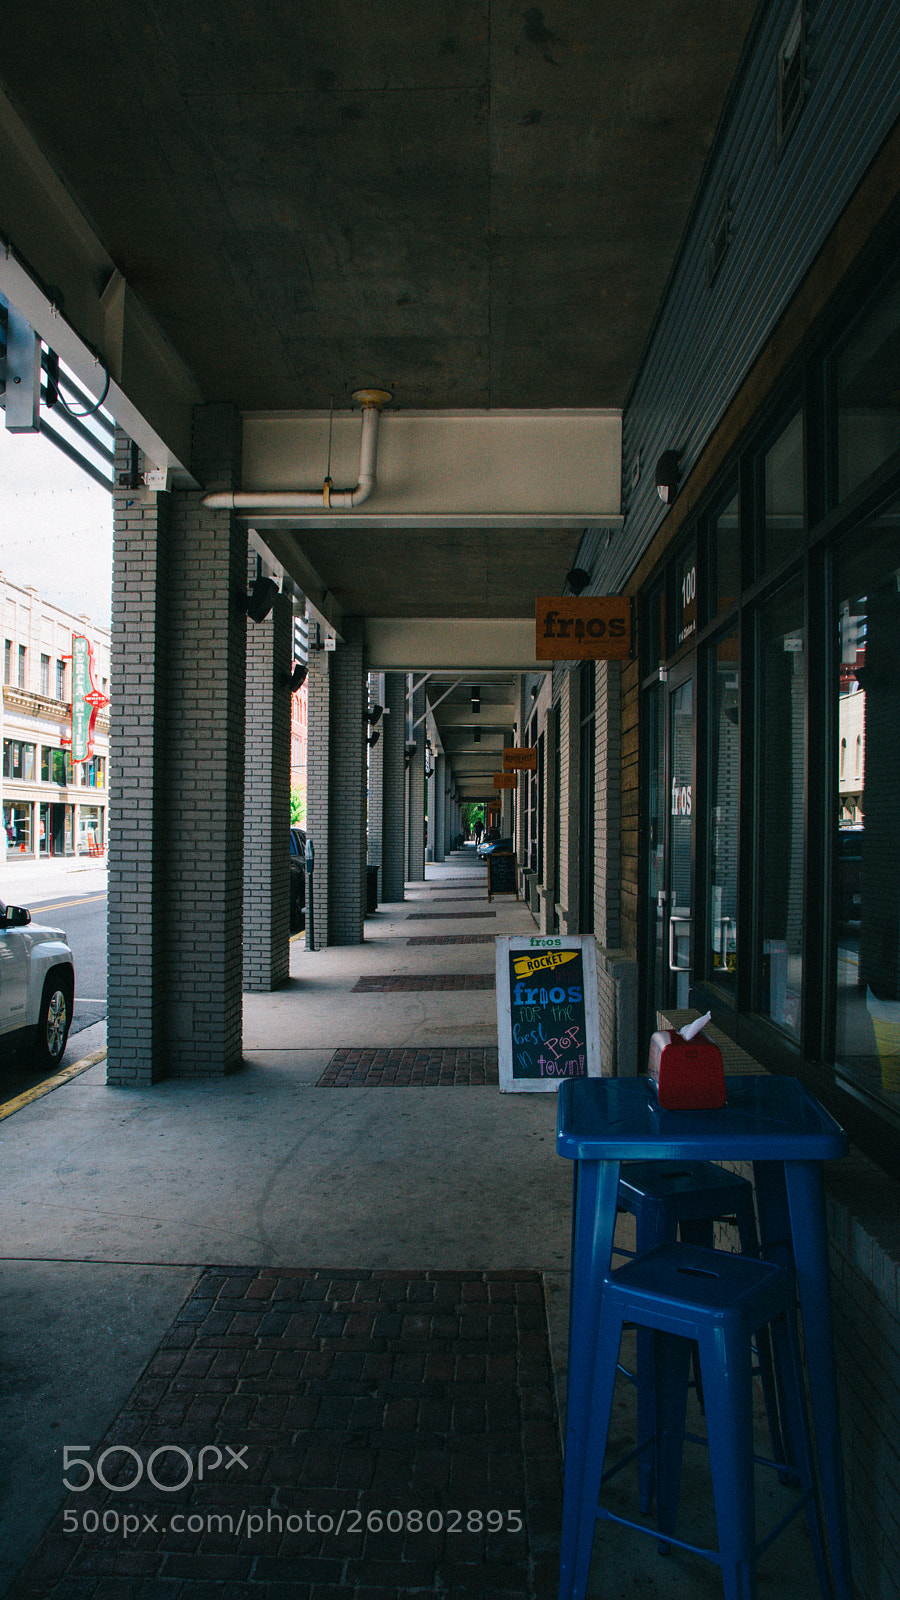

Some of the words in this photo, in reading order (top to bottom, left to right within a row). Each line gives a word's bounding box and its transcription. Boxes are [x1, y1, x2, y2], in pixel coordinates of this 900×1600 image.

[681, 566, 696, 609] 100
[543, 610, 626, 644] frios
[75, 641, 86, 756] MERCANTILE
[526, 953, 564, 971] ROCKET
[513, 981, 583, 1009] frios
[512, 1022, 548, 1045] best
[537, 1054, 585, 1076] town!
